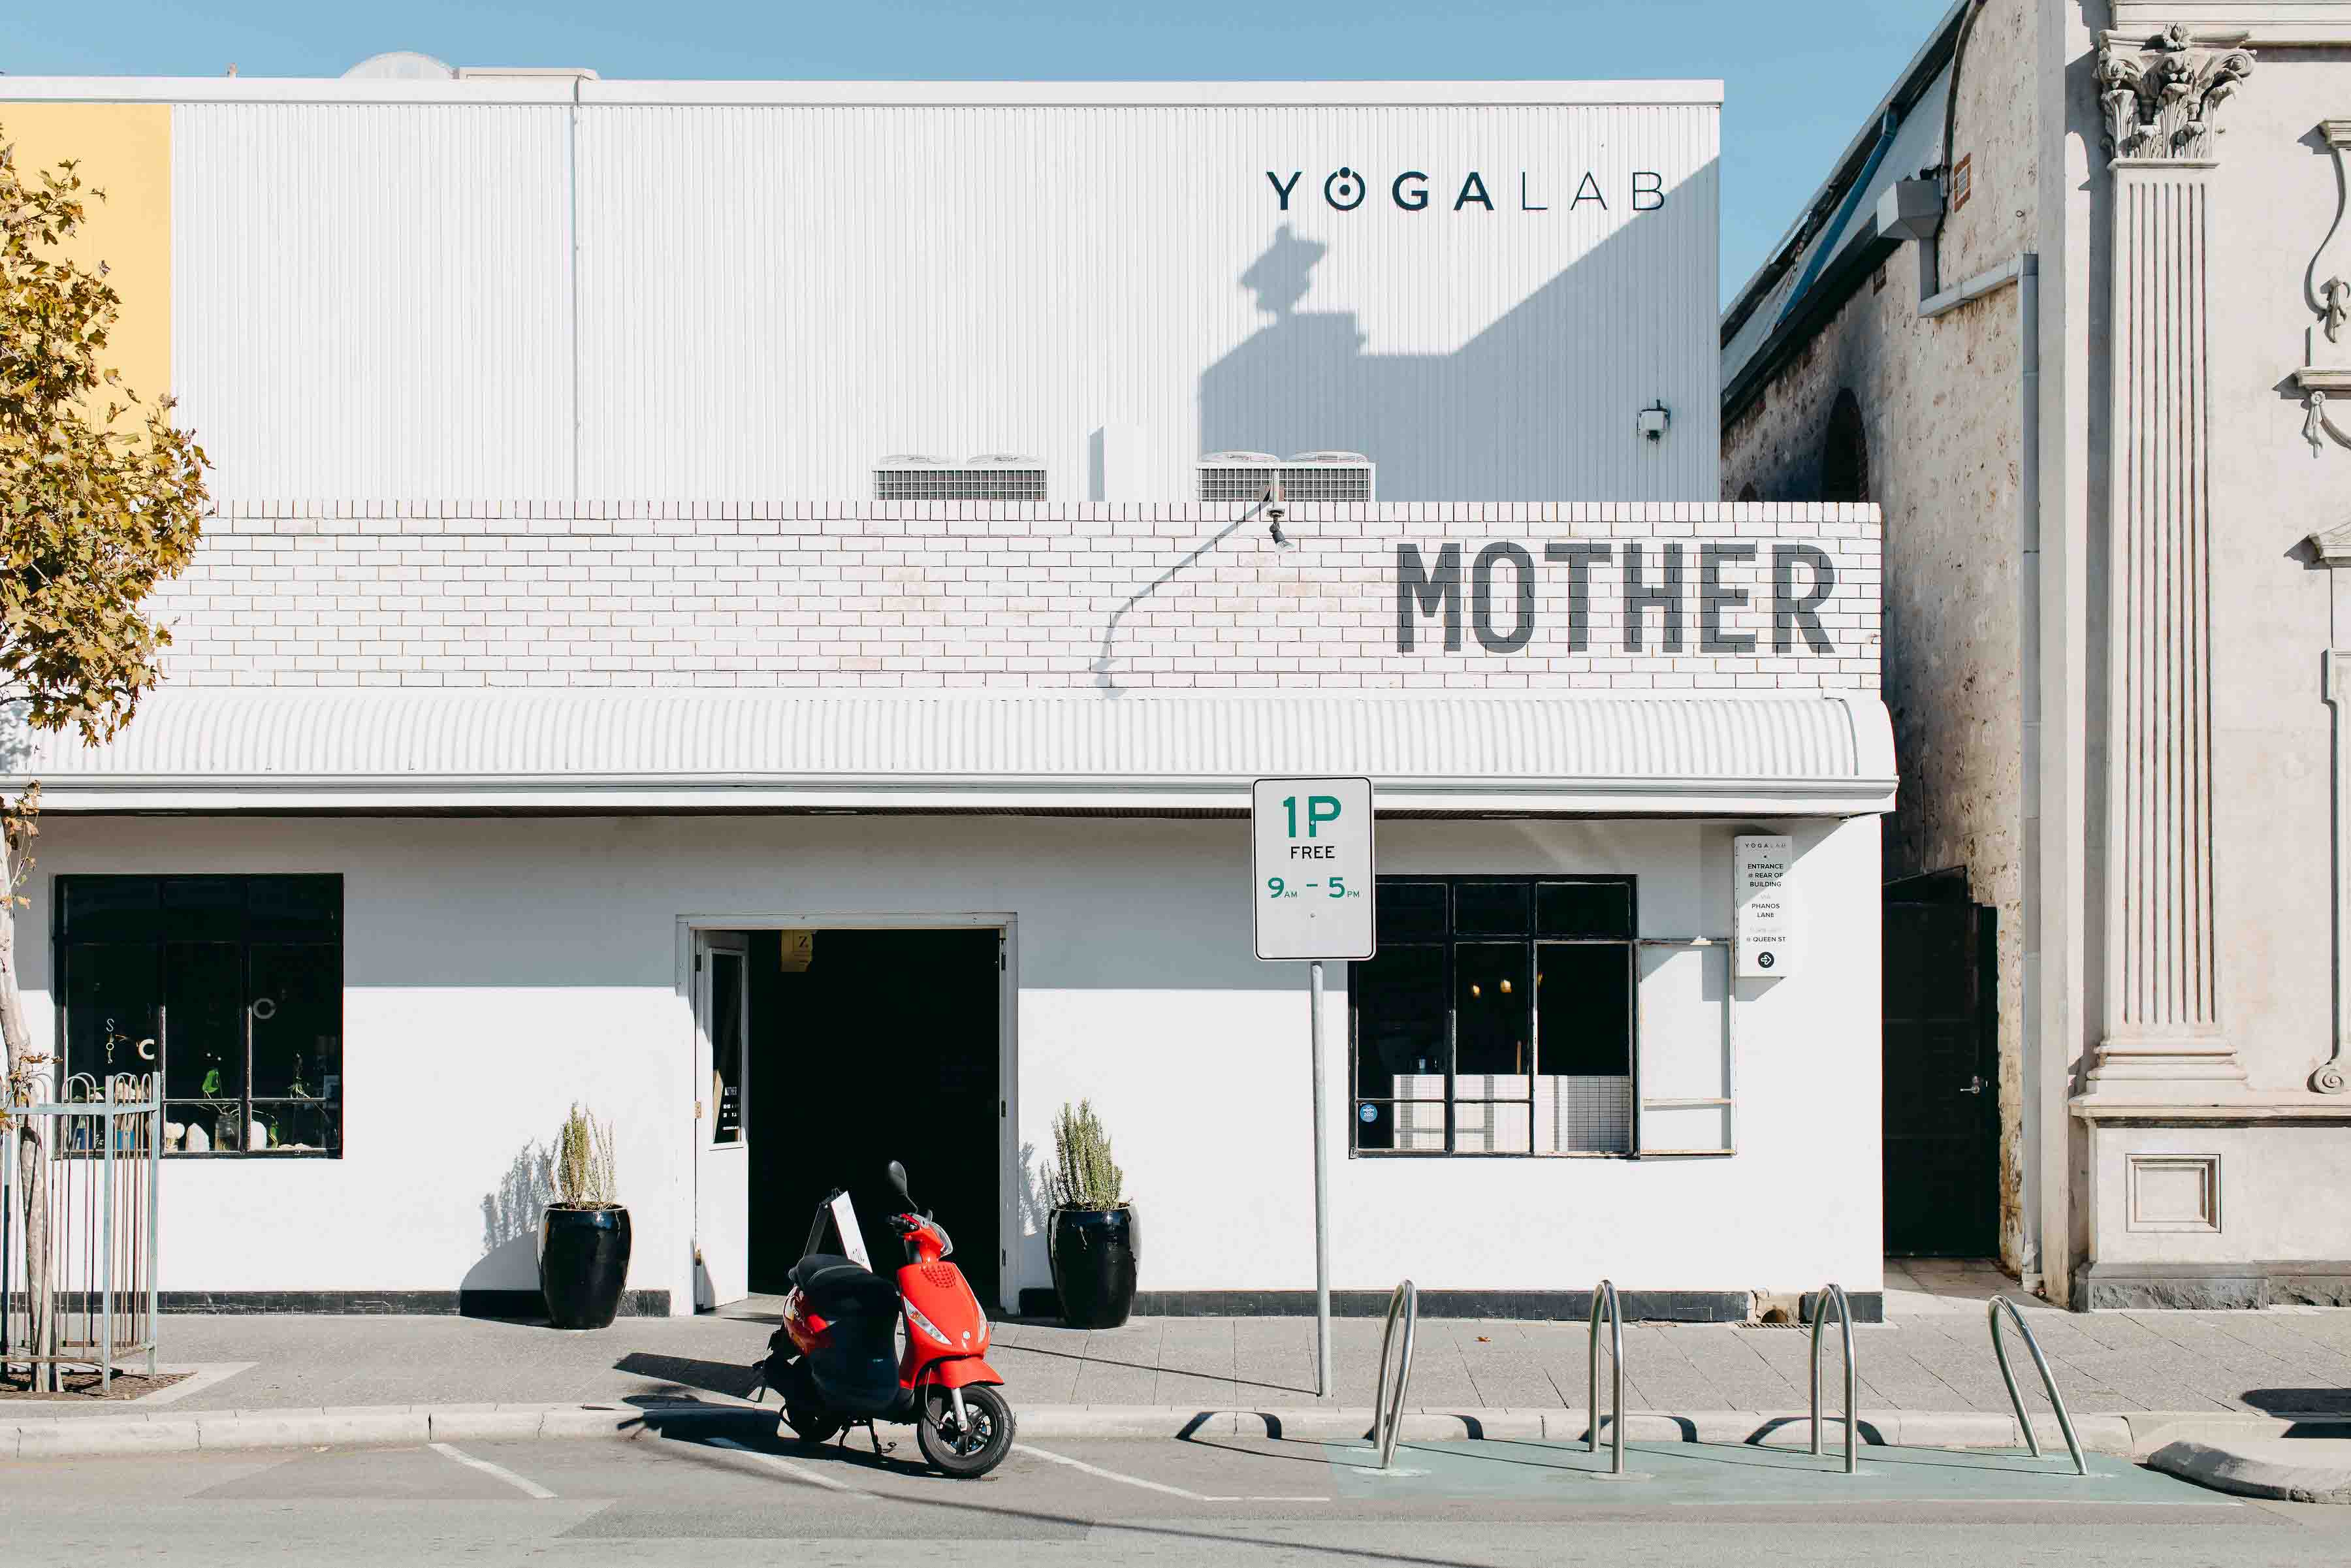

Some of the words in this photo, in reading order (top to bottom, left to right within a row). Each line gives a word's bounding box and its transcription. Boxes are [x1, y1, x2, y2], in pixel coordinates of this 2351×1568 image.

[1266, 167, 1665, 211] YOGALAB
[1397, 541, 1836, 654] MOTHER
[1283, 795, 1341, 838] 1P
[1290, 846, 1335, 859] FREE
